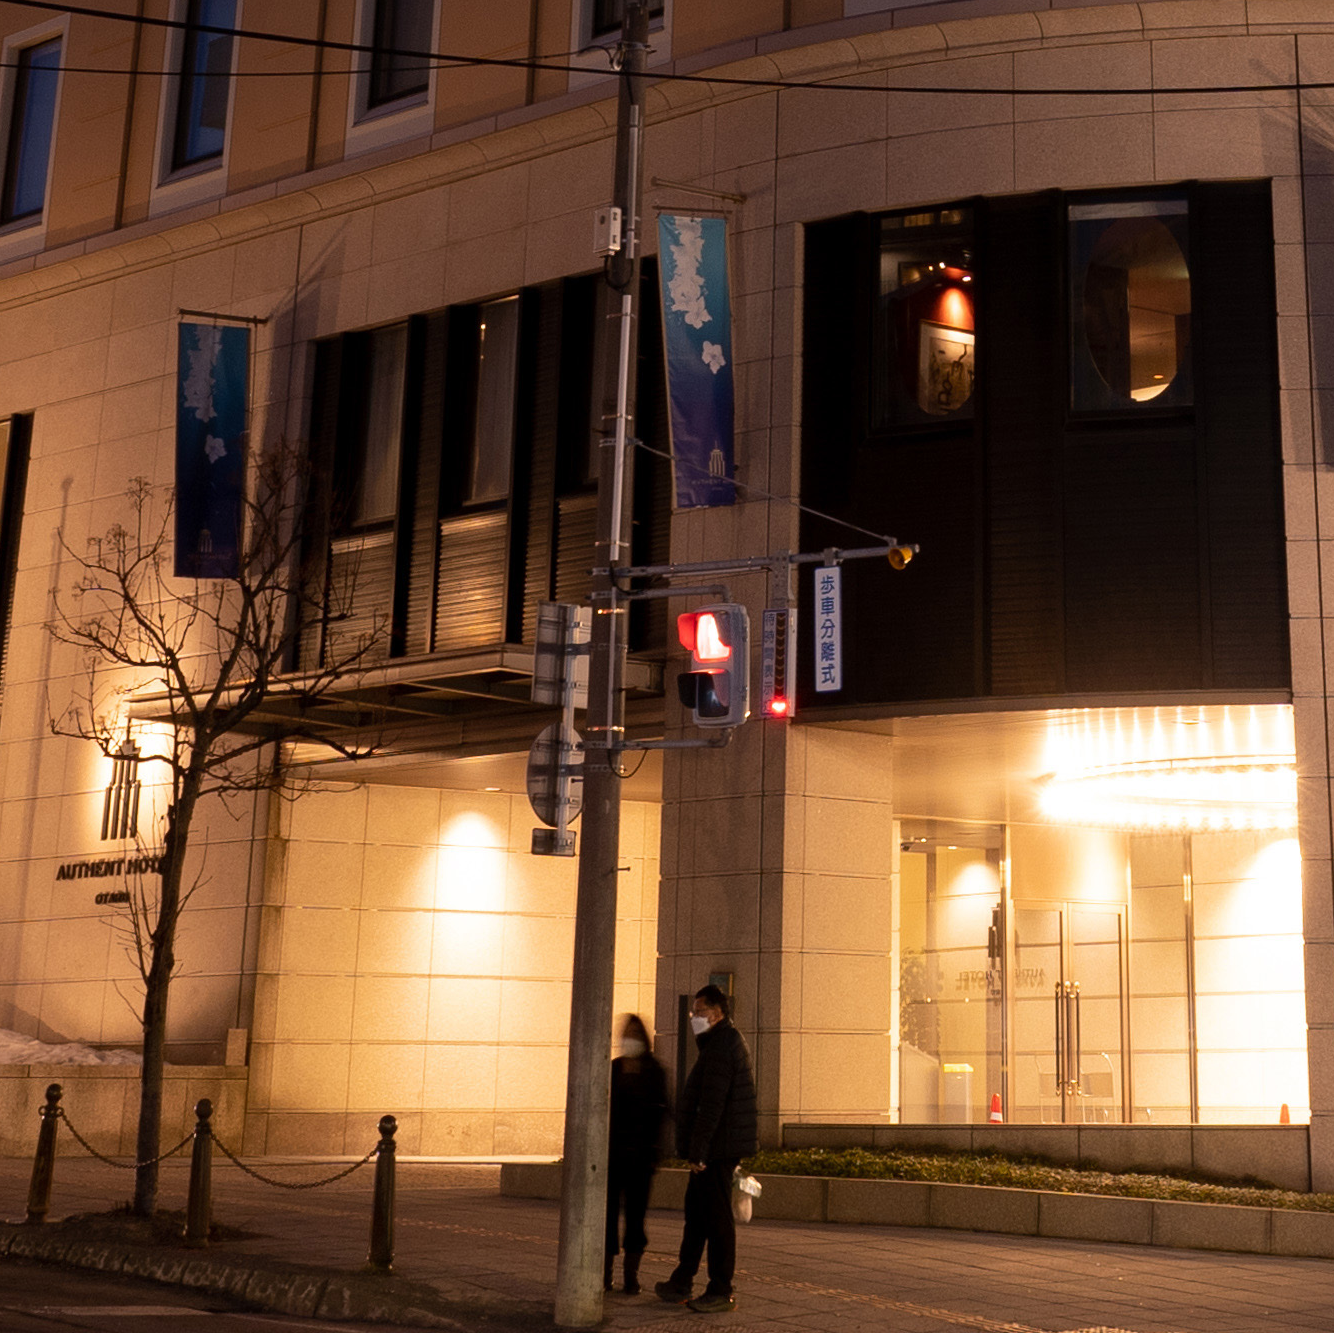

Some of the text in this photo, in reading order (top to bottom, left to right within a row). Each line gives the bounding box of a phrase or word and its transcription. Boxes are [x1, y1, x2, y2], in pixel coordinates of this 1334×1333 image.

[820, 574, 836, 684] 歩車分離式
[56, 860, 125, 880] AUTHENT
